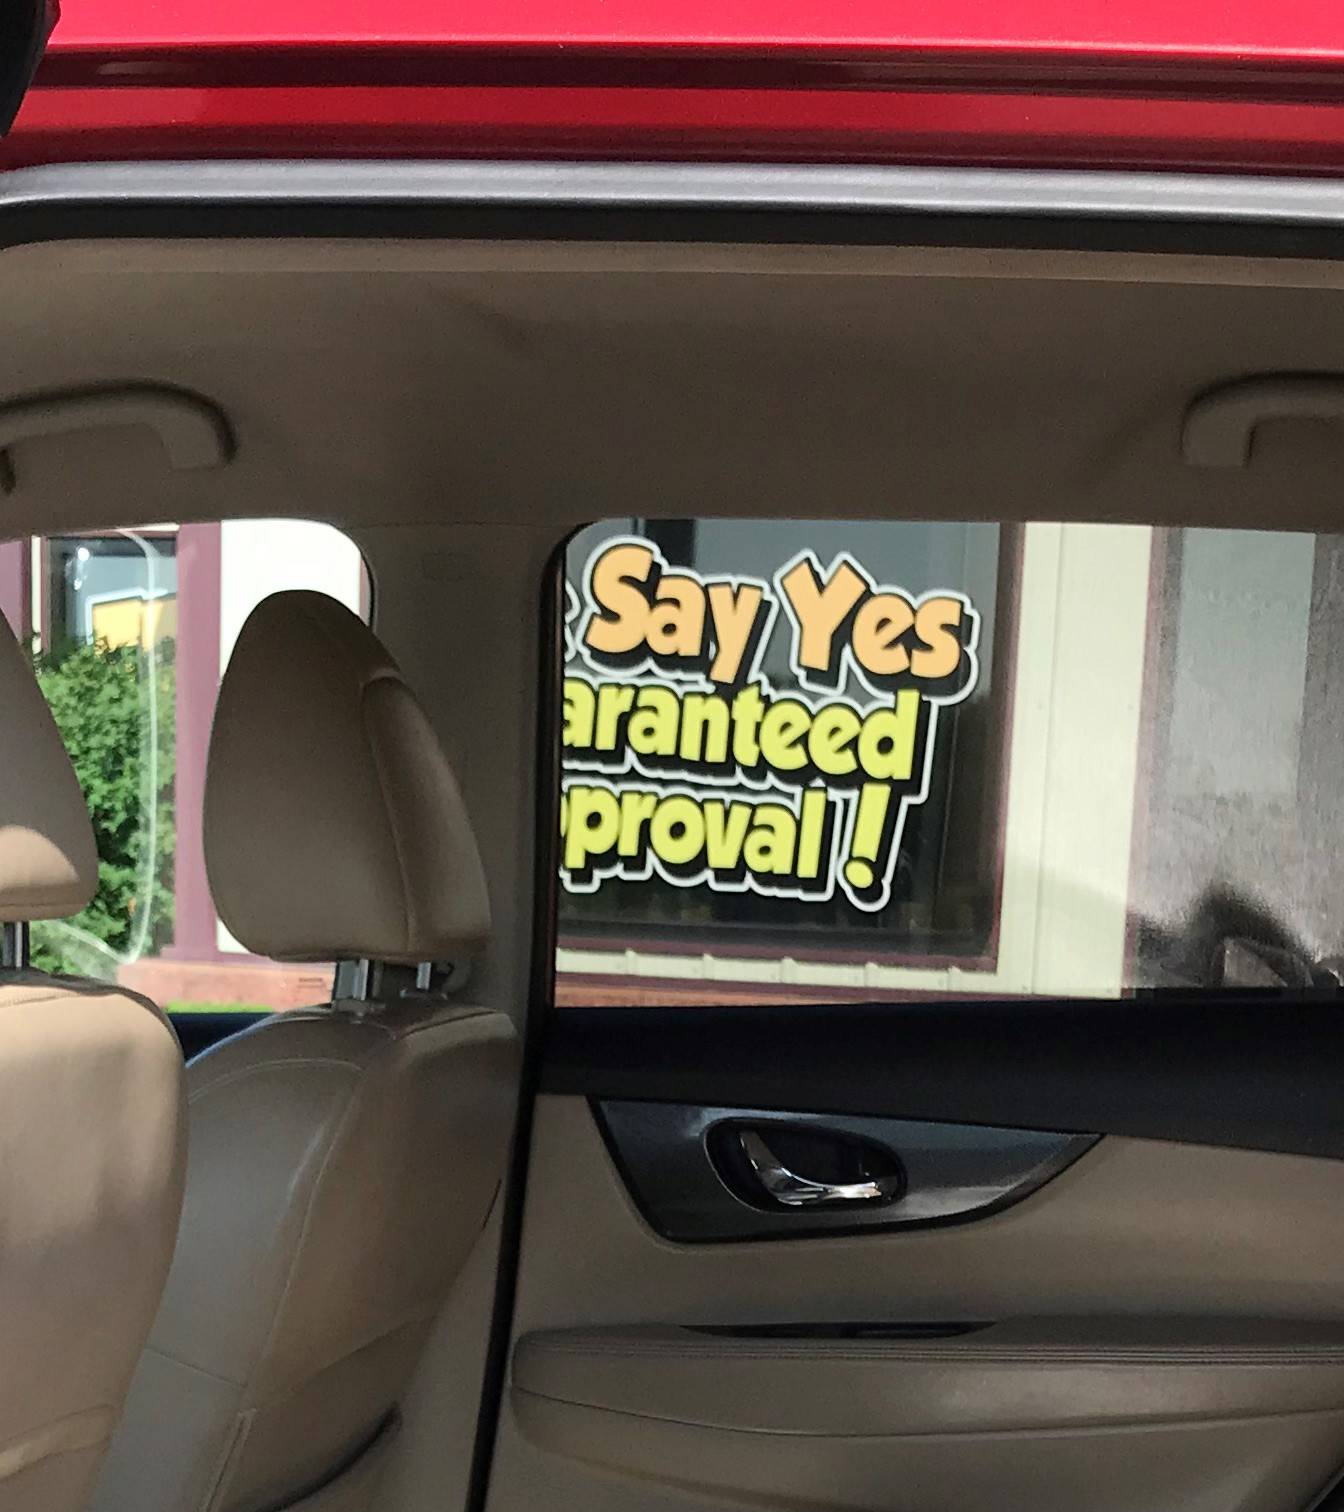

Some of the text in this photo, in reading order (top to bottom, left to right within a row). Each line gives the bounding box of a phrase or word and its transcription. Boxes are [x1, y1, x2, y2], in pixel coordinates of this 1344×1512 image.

[581, 541, 970, 686] Say Yes
[562, 677, 923, 782] aranteed
